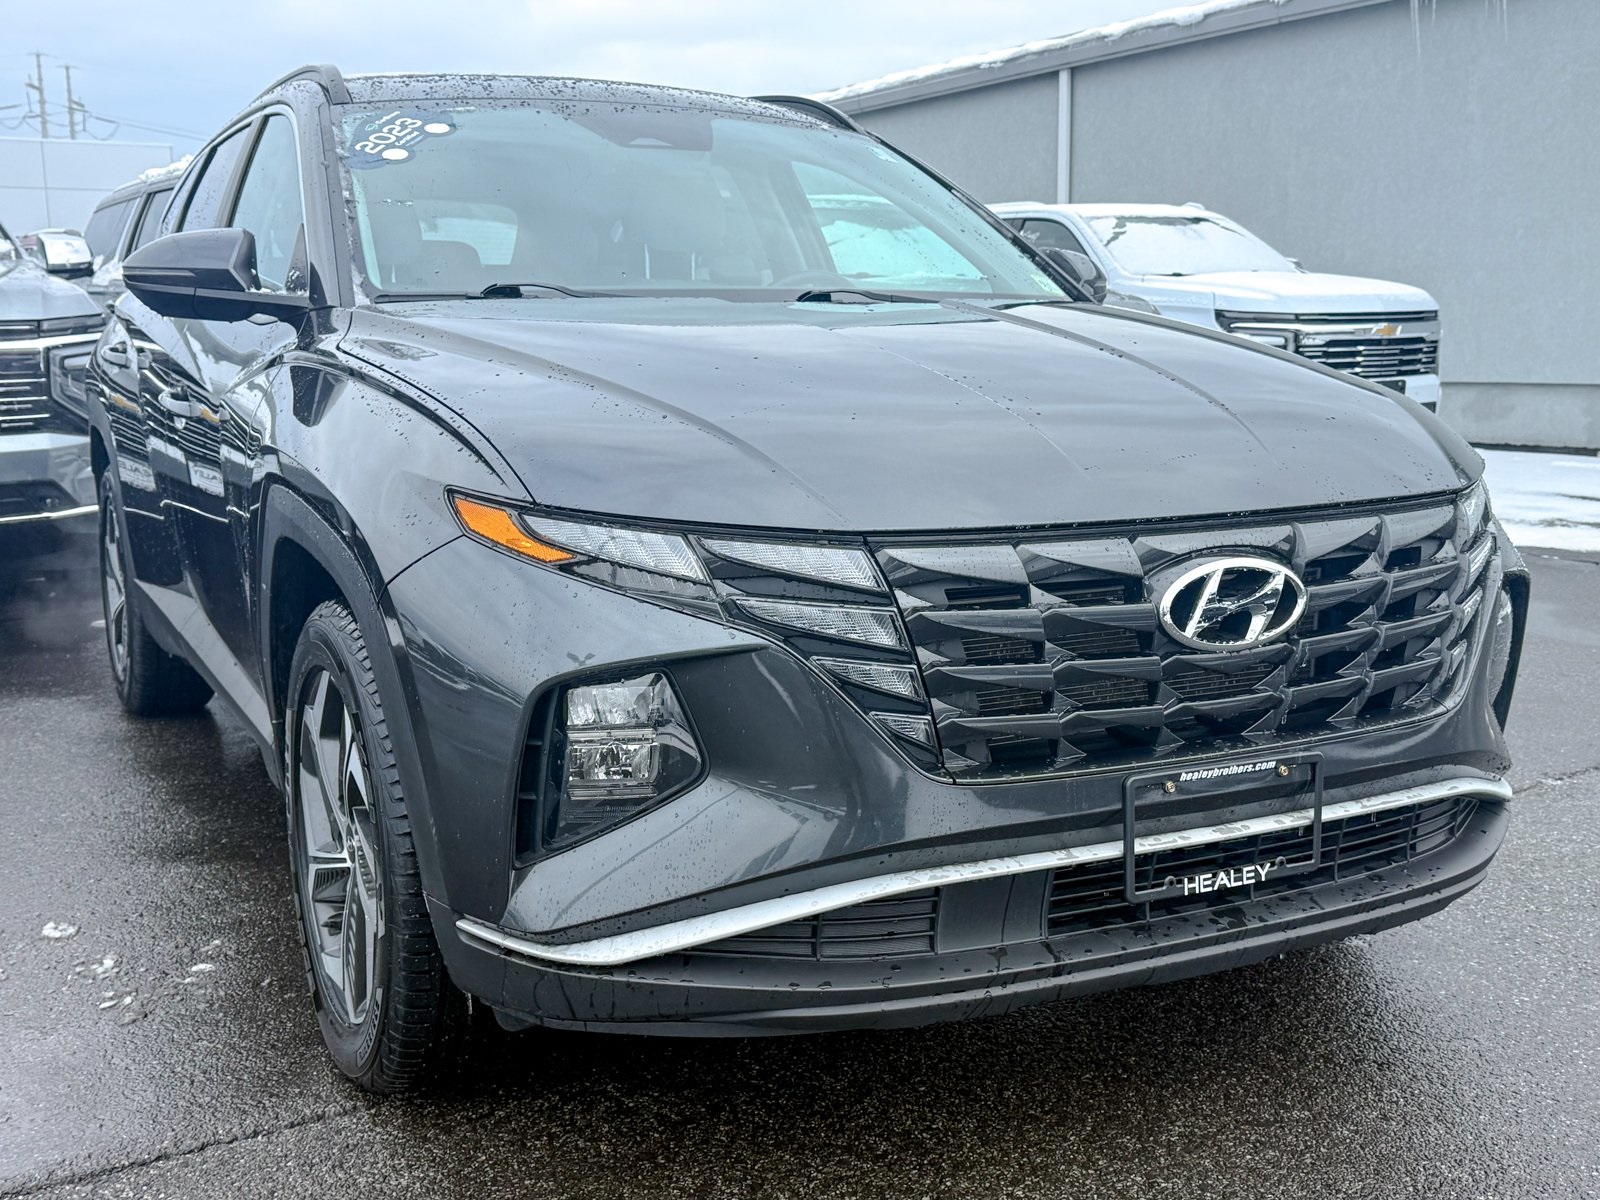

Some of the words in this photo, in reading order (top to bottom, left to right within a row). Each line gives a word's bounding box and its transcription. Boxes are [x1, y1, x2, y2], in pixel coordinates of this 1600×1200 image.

[355, 118, 422, 154] 2023
[1179, 761, 1277, 782] healeybrothers.com
[1184, 863, 1271, 896] HEALEY
